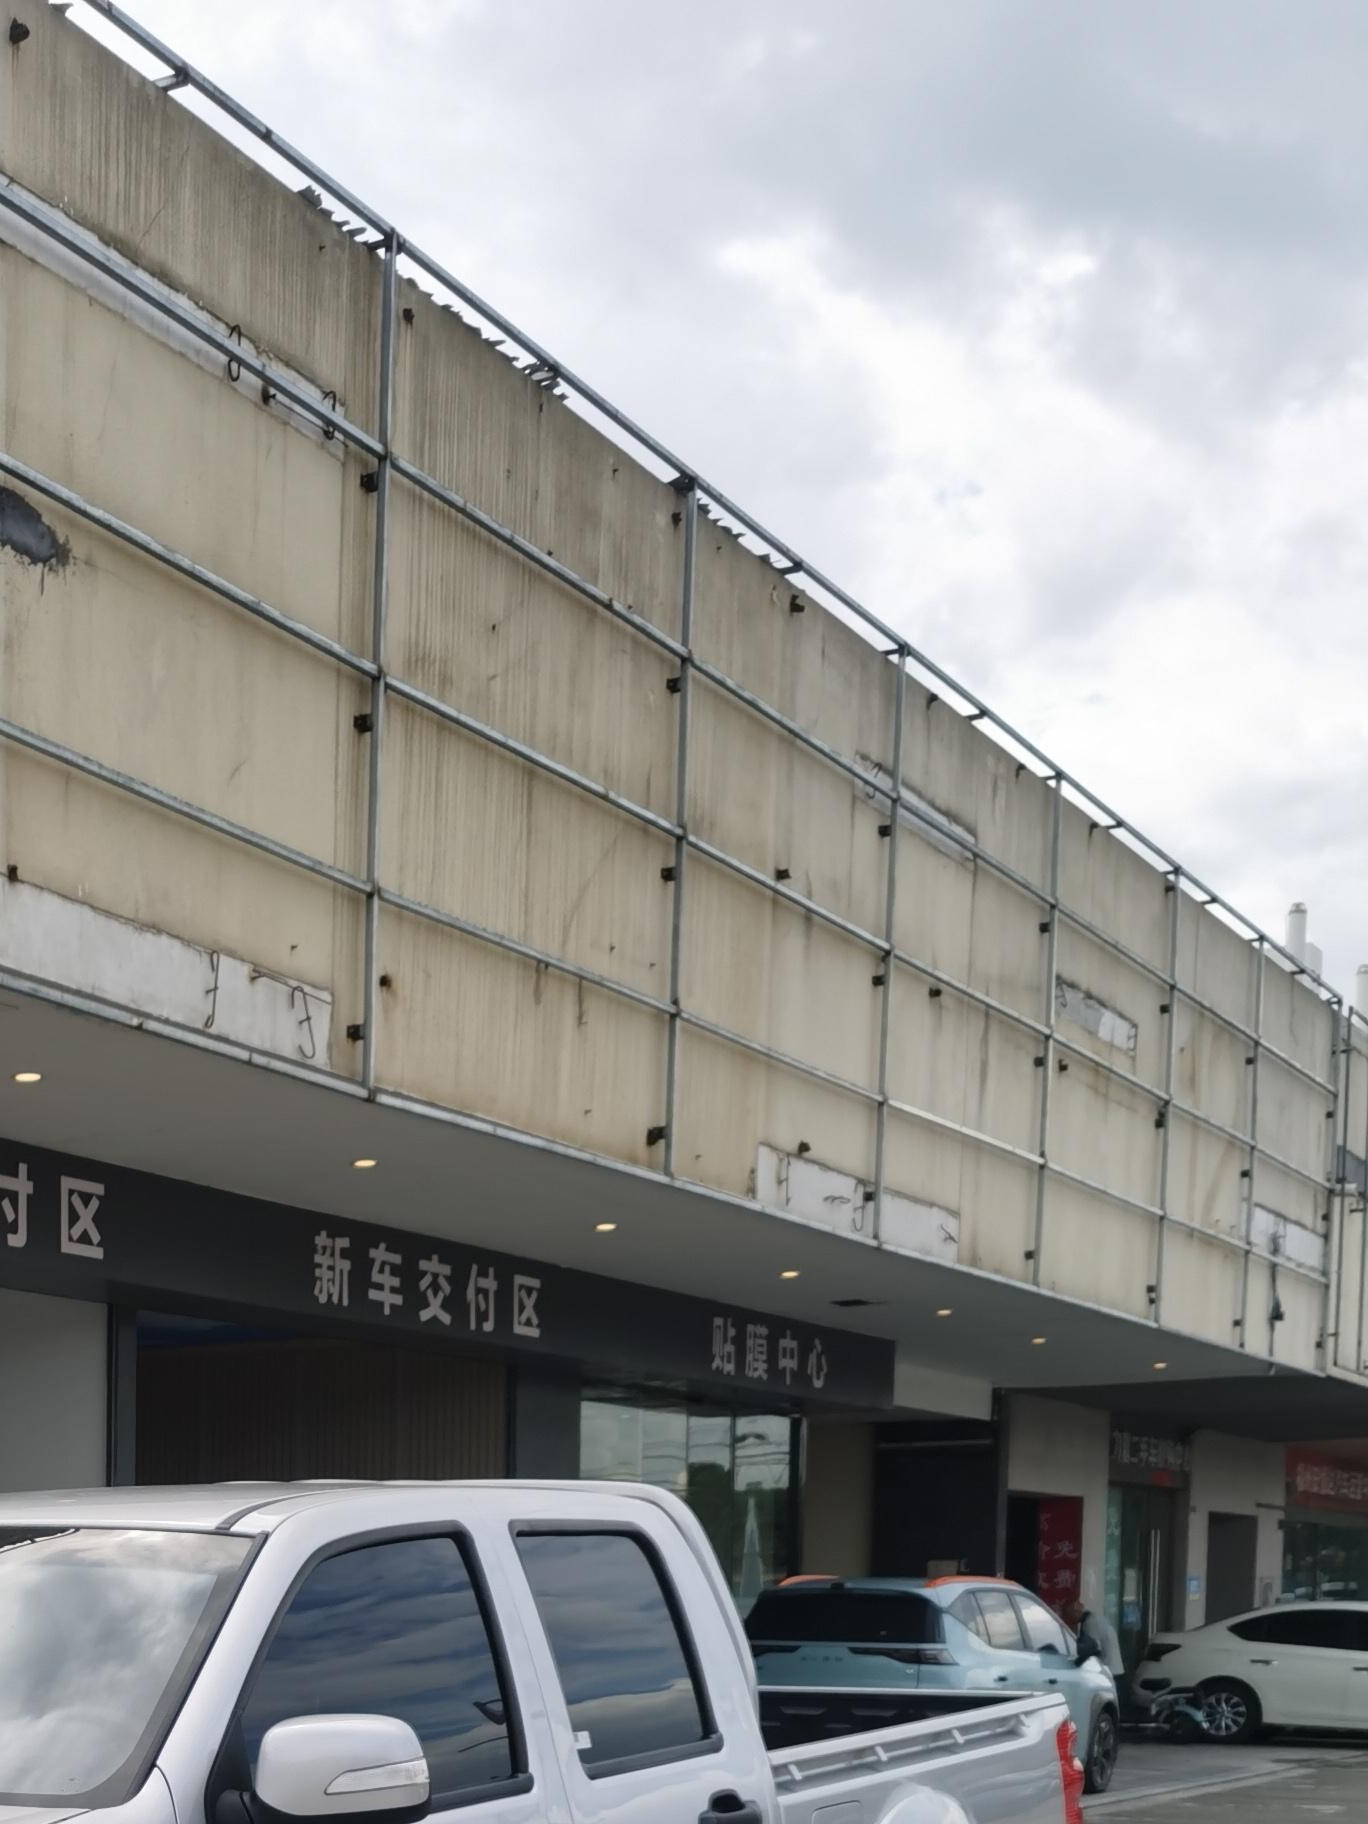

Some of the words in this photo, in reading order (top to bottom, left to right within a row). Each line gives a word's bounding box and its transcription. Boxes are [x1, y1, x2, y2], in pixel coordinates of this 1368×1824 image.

[313, 1230, 542, 1338] 新车交付区
[712, 1316, 828, 1389] 贴膜中心
